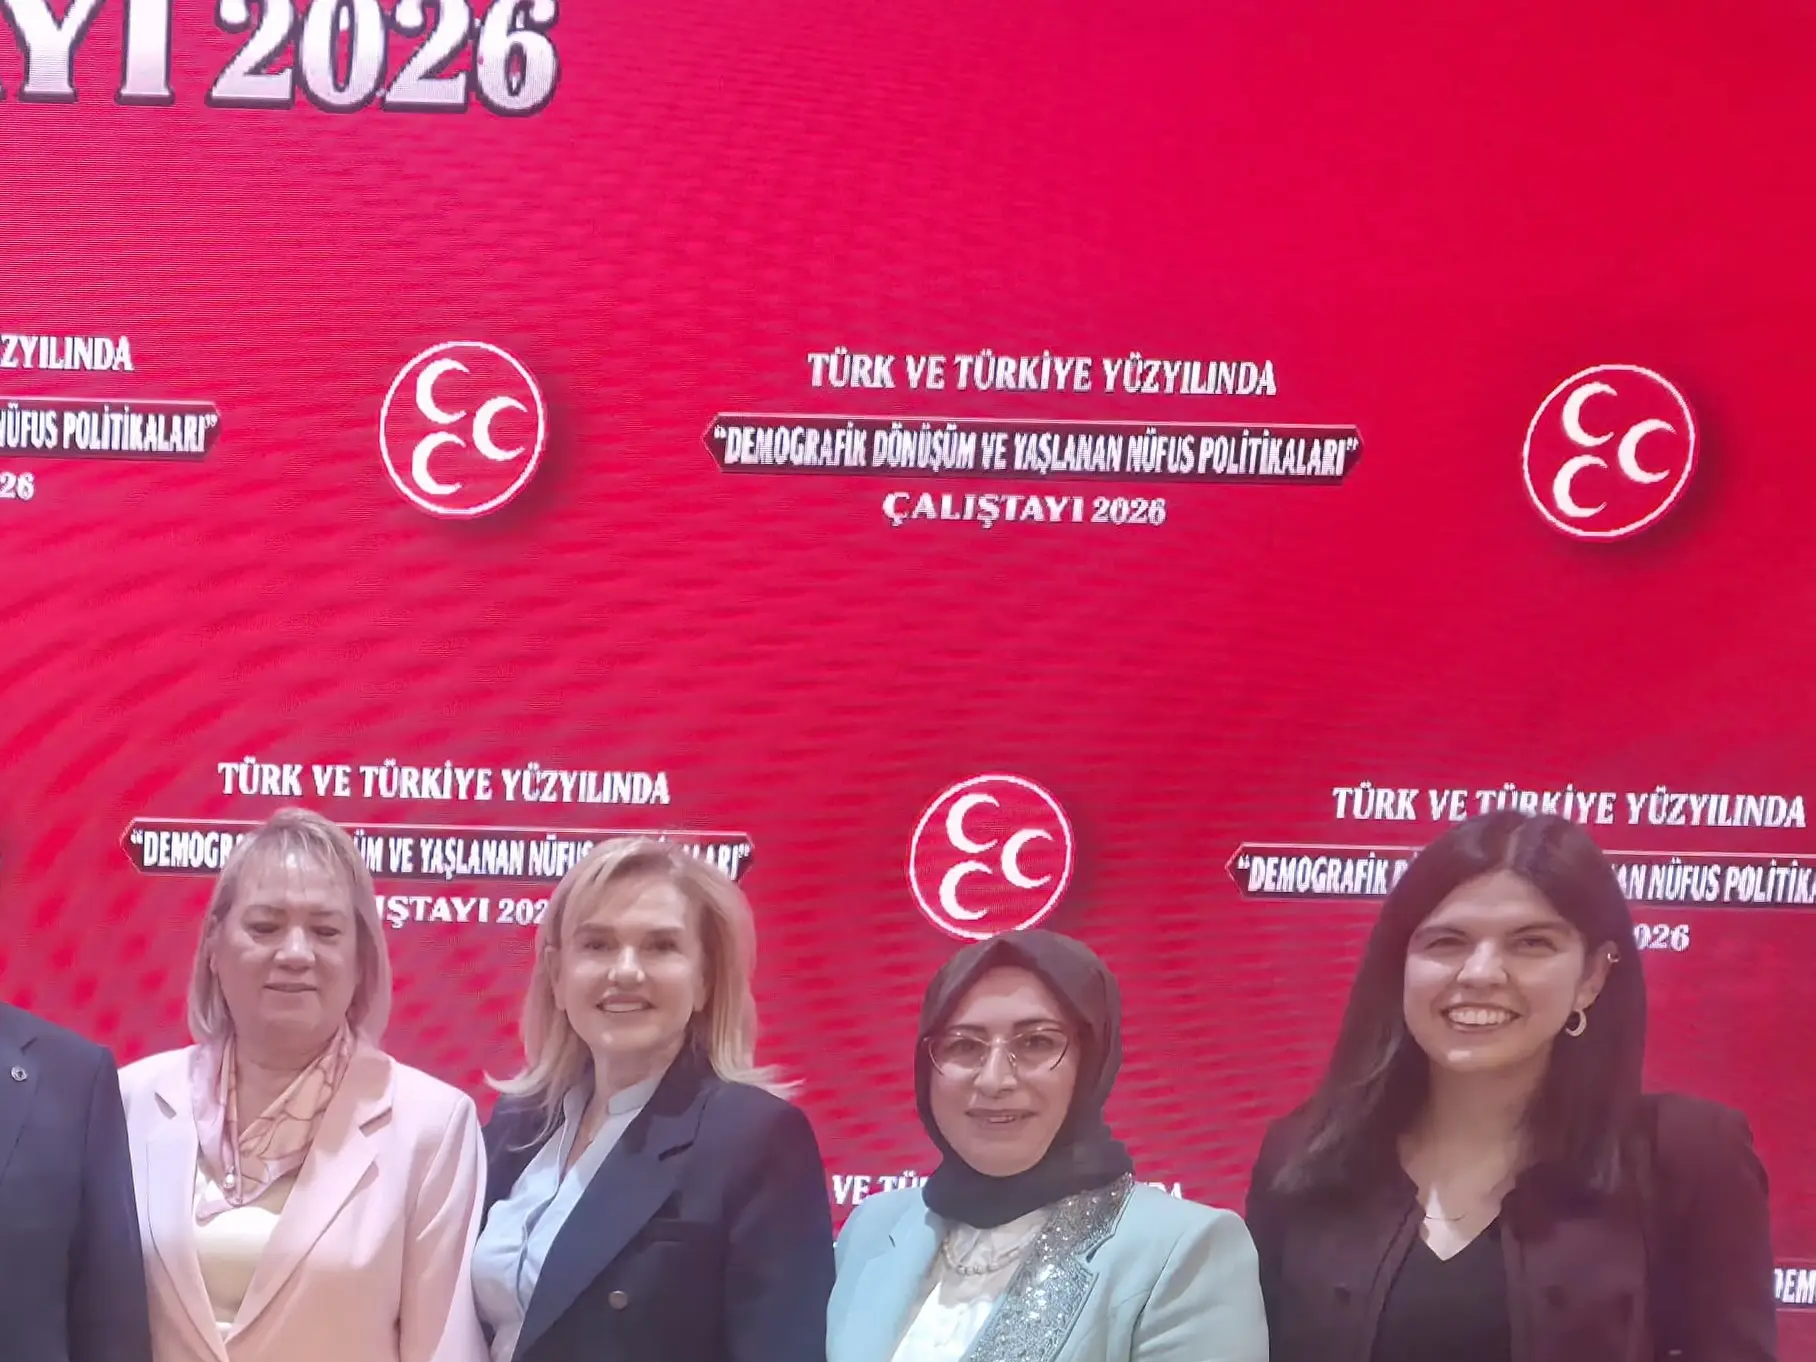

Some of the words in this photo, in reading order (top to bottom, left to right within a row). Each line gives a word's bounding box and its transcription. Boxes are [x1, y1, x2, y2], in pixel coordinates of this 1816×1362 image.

[209, 0, 558, 112] 2026
[807, 347, 895, 388] TÜRK
[905, 355, 946, 389] VE
[954, 350, 1092, 390] TÜRKİYE
[1102, 352, 1277, 396] YÜZYILINDA
[872, 418, 979, 471] DÖNÜŞÜM
[981, 432, 1008, 470] VE
[1014, 432, 1123, 475] YAŞLANAN
[1126, 427, 1195, 474] NÜFUS
[882, 492, 1084, 529] ÇALIŞTAYI
[1091, 496, 1166, 525] 2026
[217, 756, 303, 796] TÜRK
[312, 765, 352, 797] VE
[359, 758, 492, 801] TÜRKİYE
[501, 761, 670, 805] YÜZYILINDA
[1332, 781, 1419, 820] TÜRK
[1428, 789, 1468, 821] VE
[1627, 785, 1806, 828] YÜZYILINDA
[131, 828, 243, 868] “DEMOGR
[388, 837, 414, 873] VE
[420, 837, 525, 880] YAŞLANAN
[1647, 857, 1721, 902] NÜFUS
[375, 895, 490, 929] IŞTAYI
[496, 897, 548, 925] 202
[1633, 923, 1690, 952] 026
[832, 1175, 871, 1205] VE
